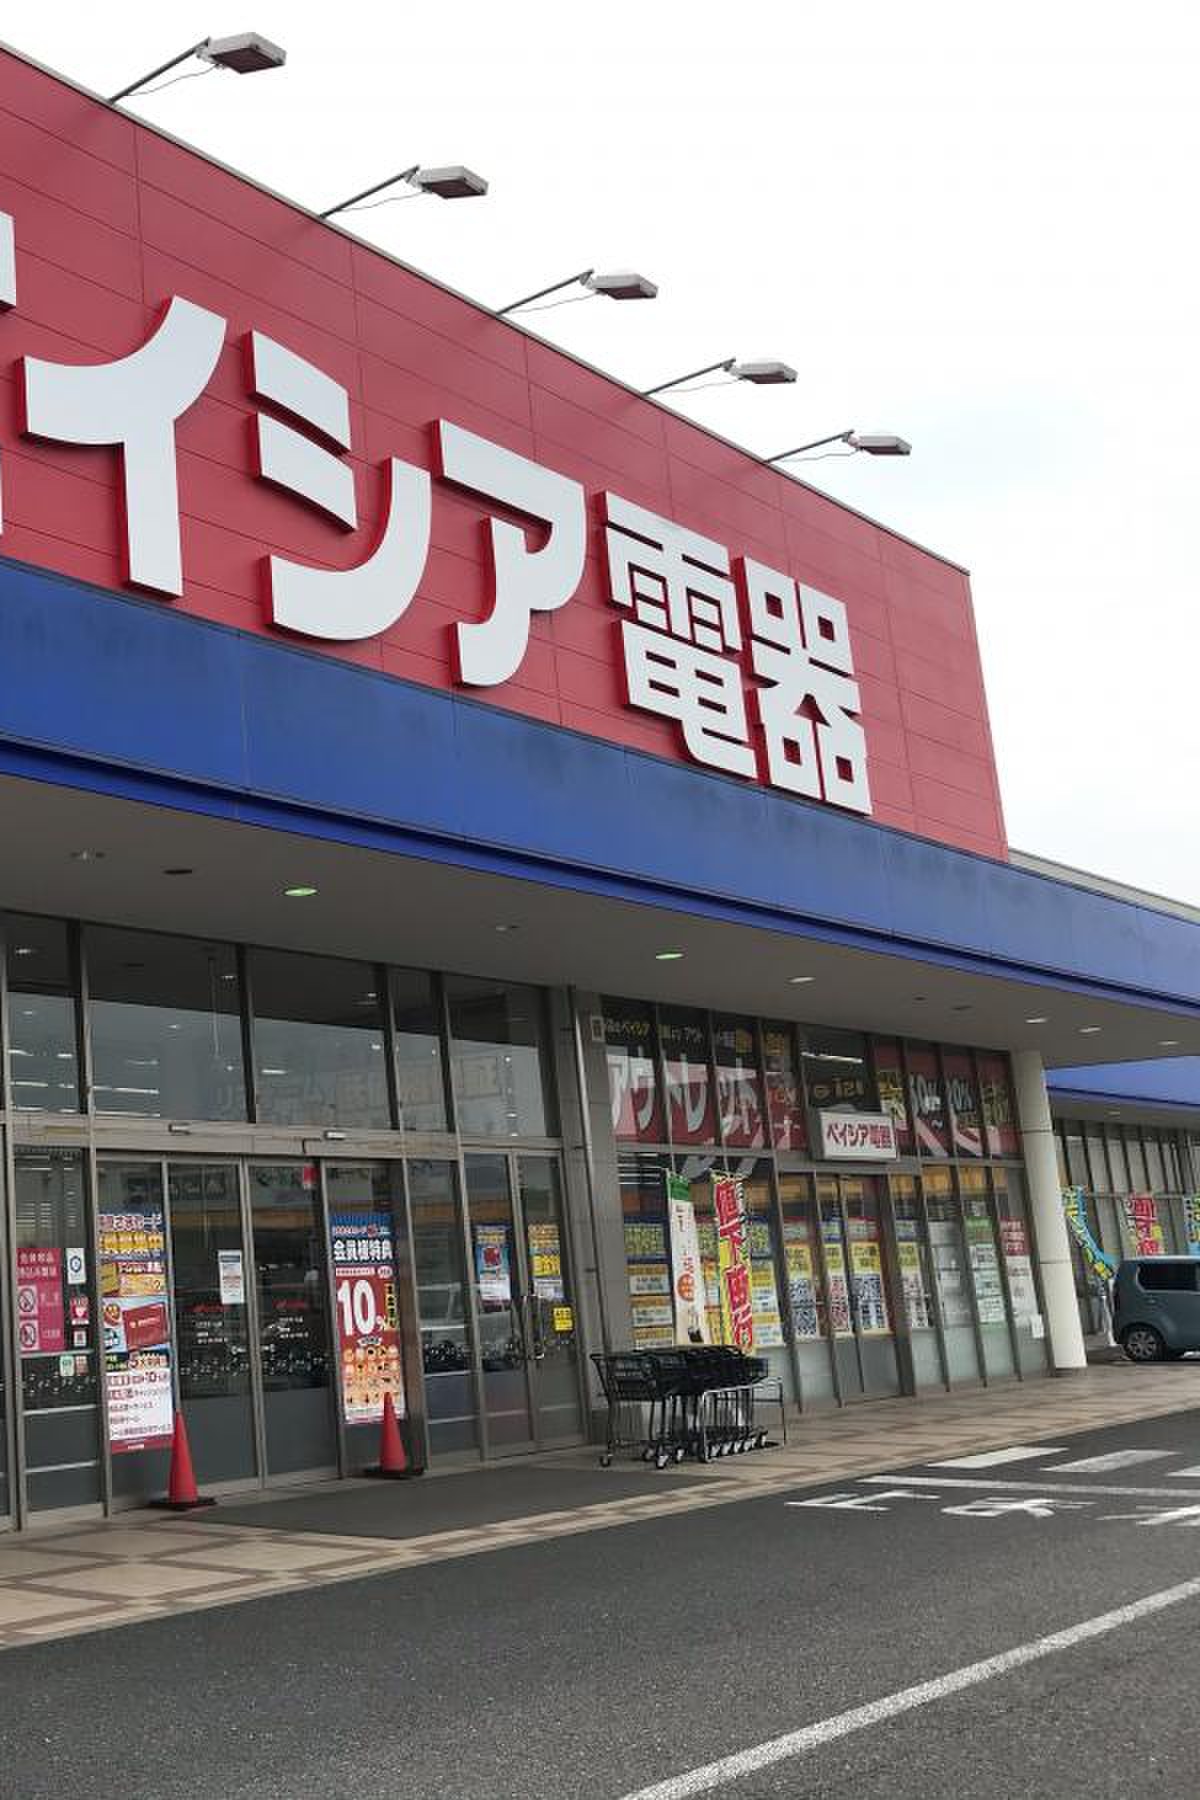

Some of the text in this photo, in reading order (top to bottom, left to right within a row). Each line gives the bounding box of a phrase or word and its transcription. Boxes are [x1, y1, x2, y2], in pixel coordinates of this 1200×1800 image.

[827, 1123, 892, 1148] ベイシア電器
